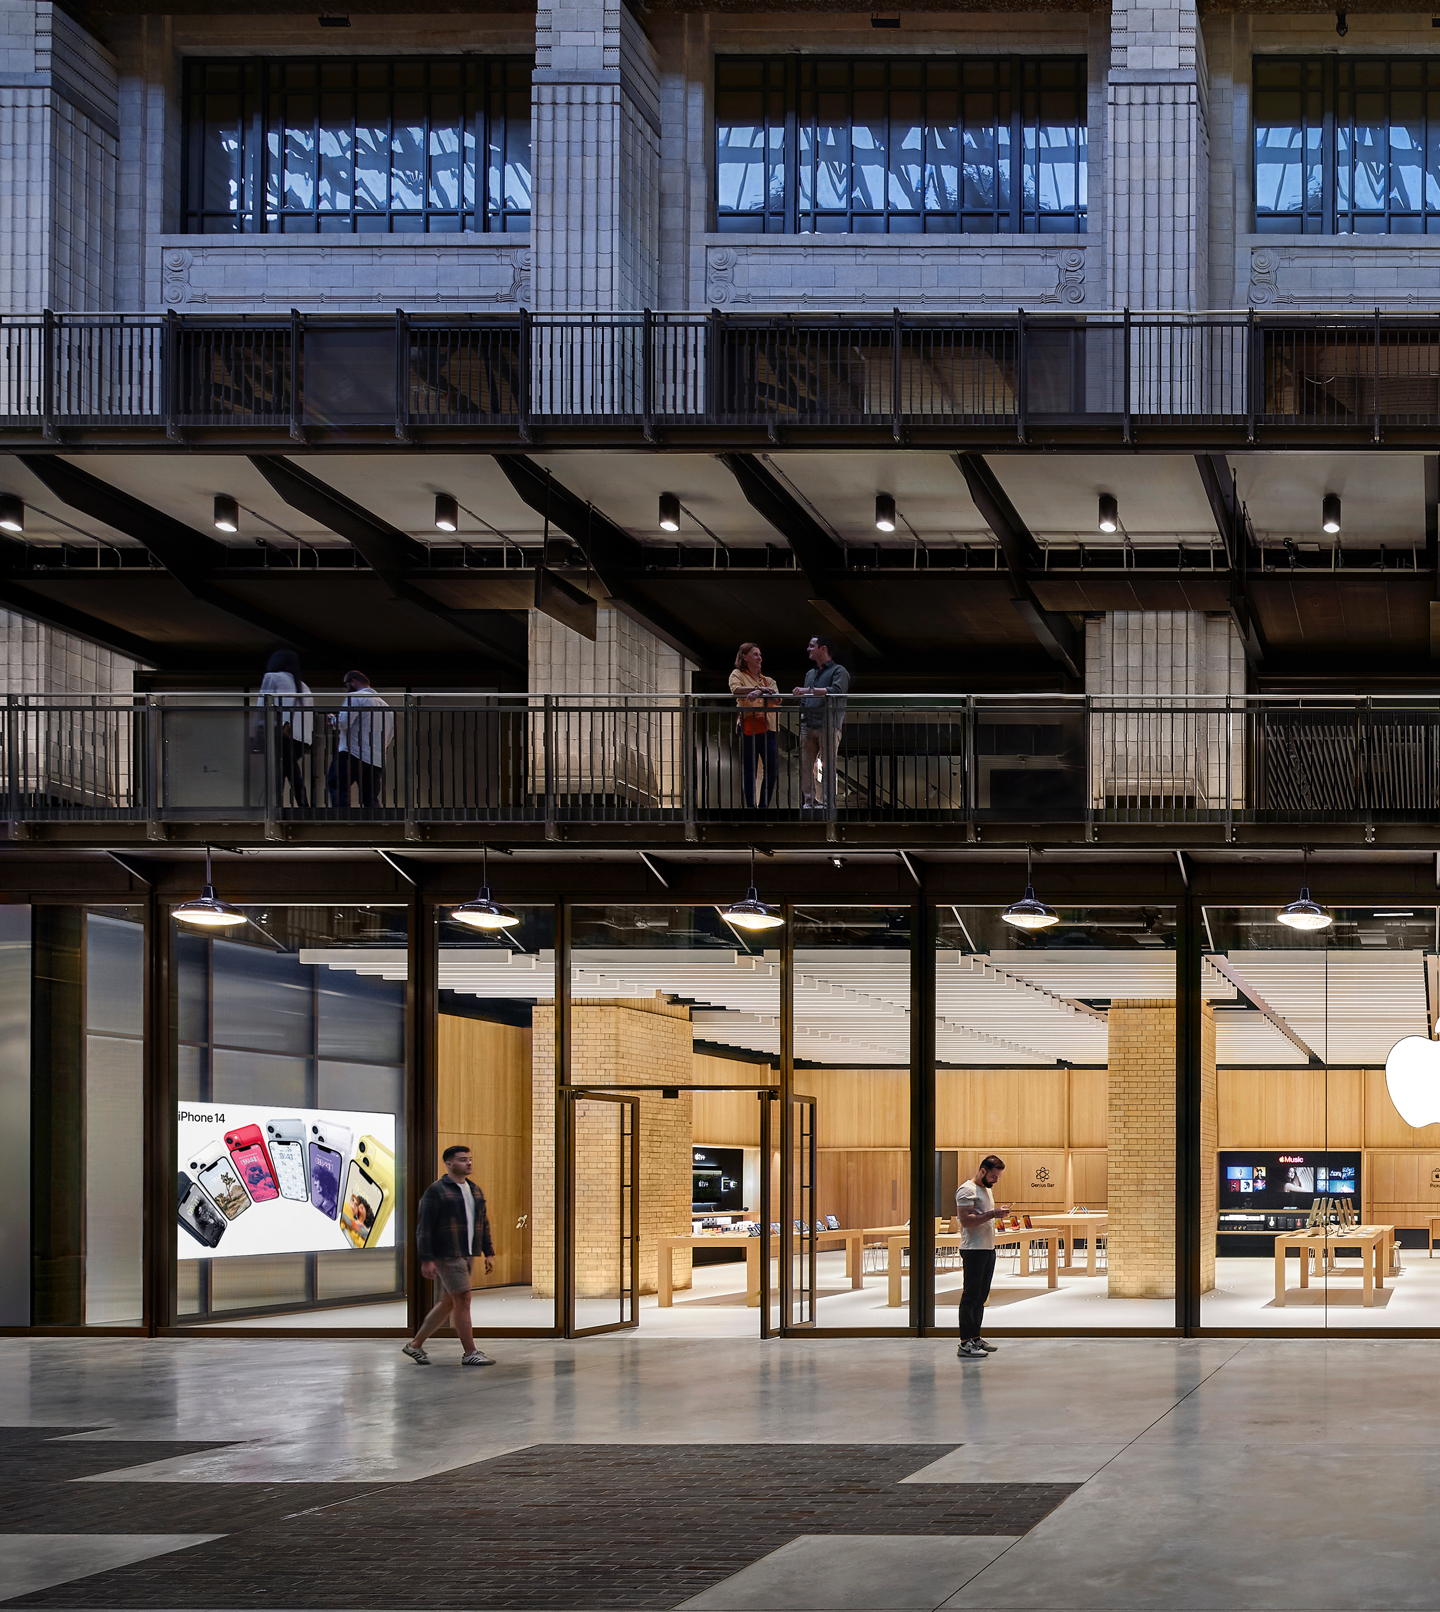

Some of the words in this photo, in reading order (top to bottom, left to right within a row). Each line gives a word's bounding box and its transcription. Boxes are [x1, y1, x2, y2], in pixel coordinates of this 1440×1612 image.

[178, 1111, 213, 1123] iPhone
[214, 1113, 226, 1123] 14
[1284, 1155, 1304, 1163] Music
